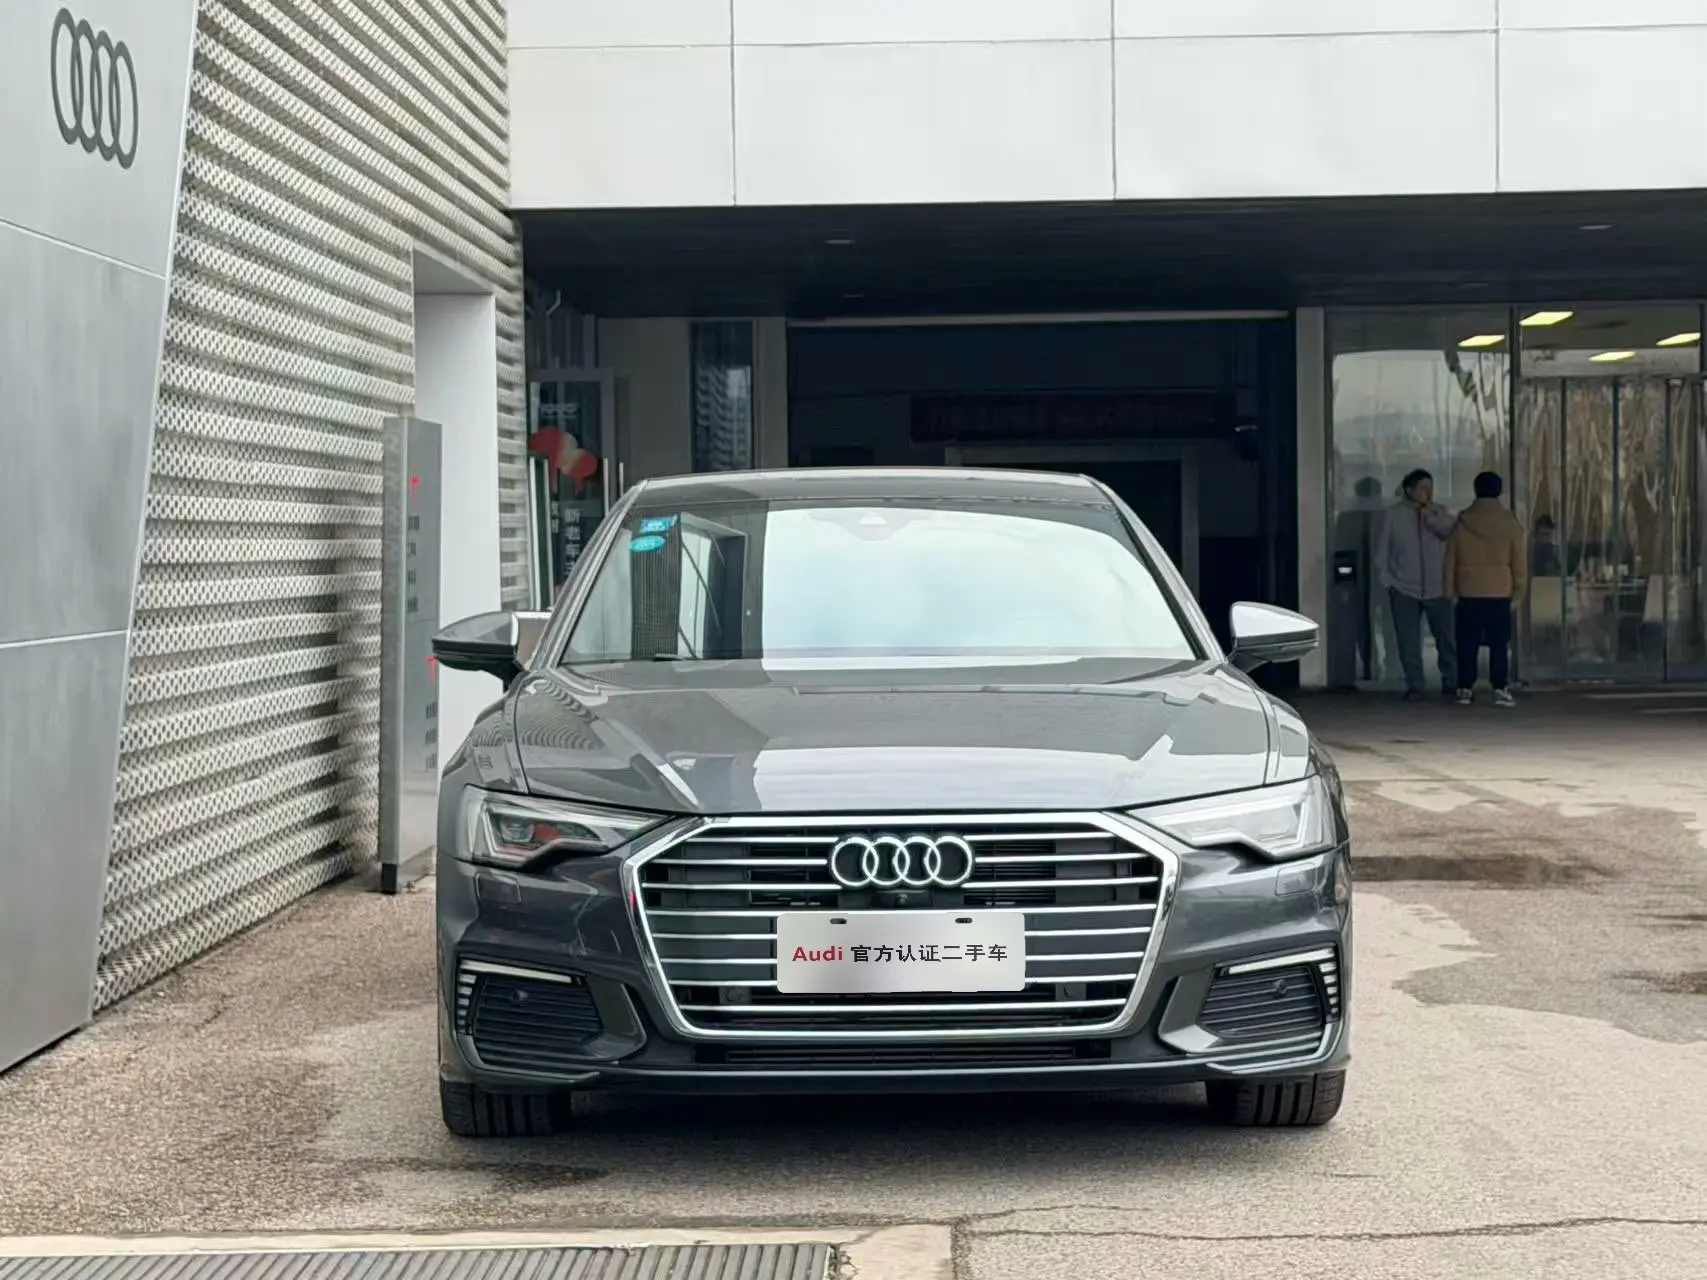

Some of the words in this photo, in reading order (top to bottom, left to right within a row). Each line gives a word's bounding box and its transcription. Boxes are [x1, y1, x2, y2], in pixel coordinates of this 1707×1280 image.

[792, 946, 843, 962] Audi
[851, 944, 1008, 963] 官方认证二手车
